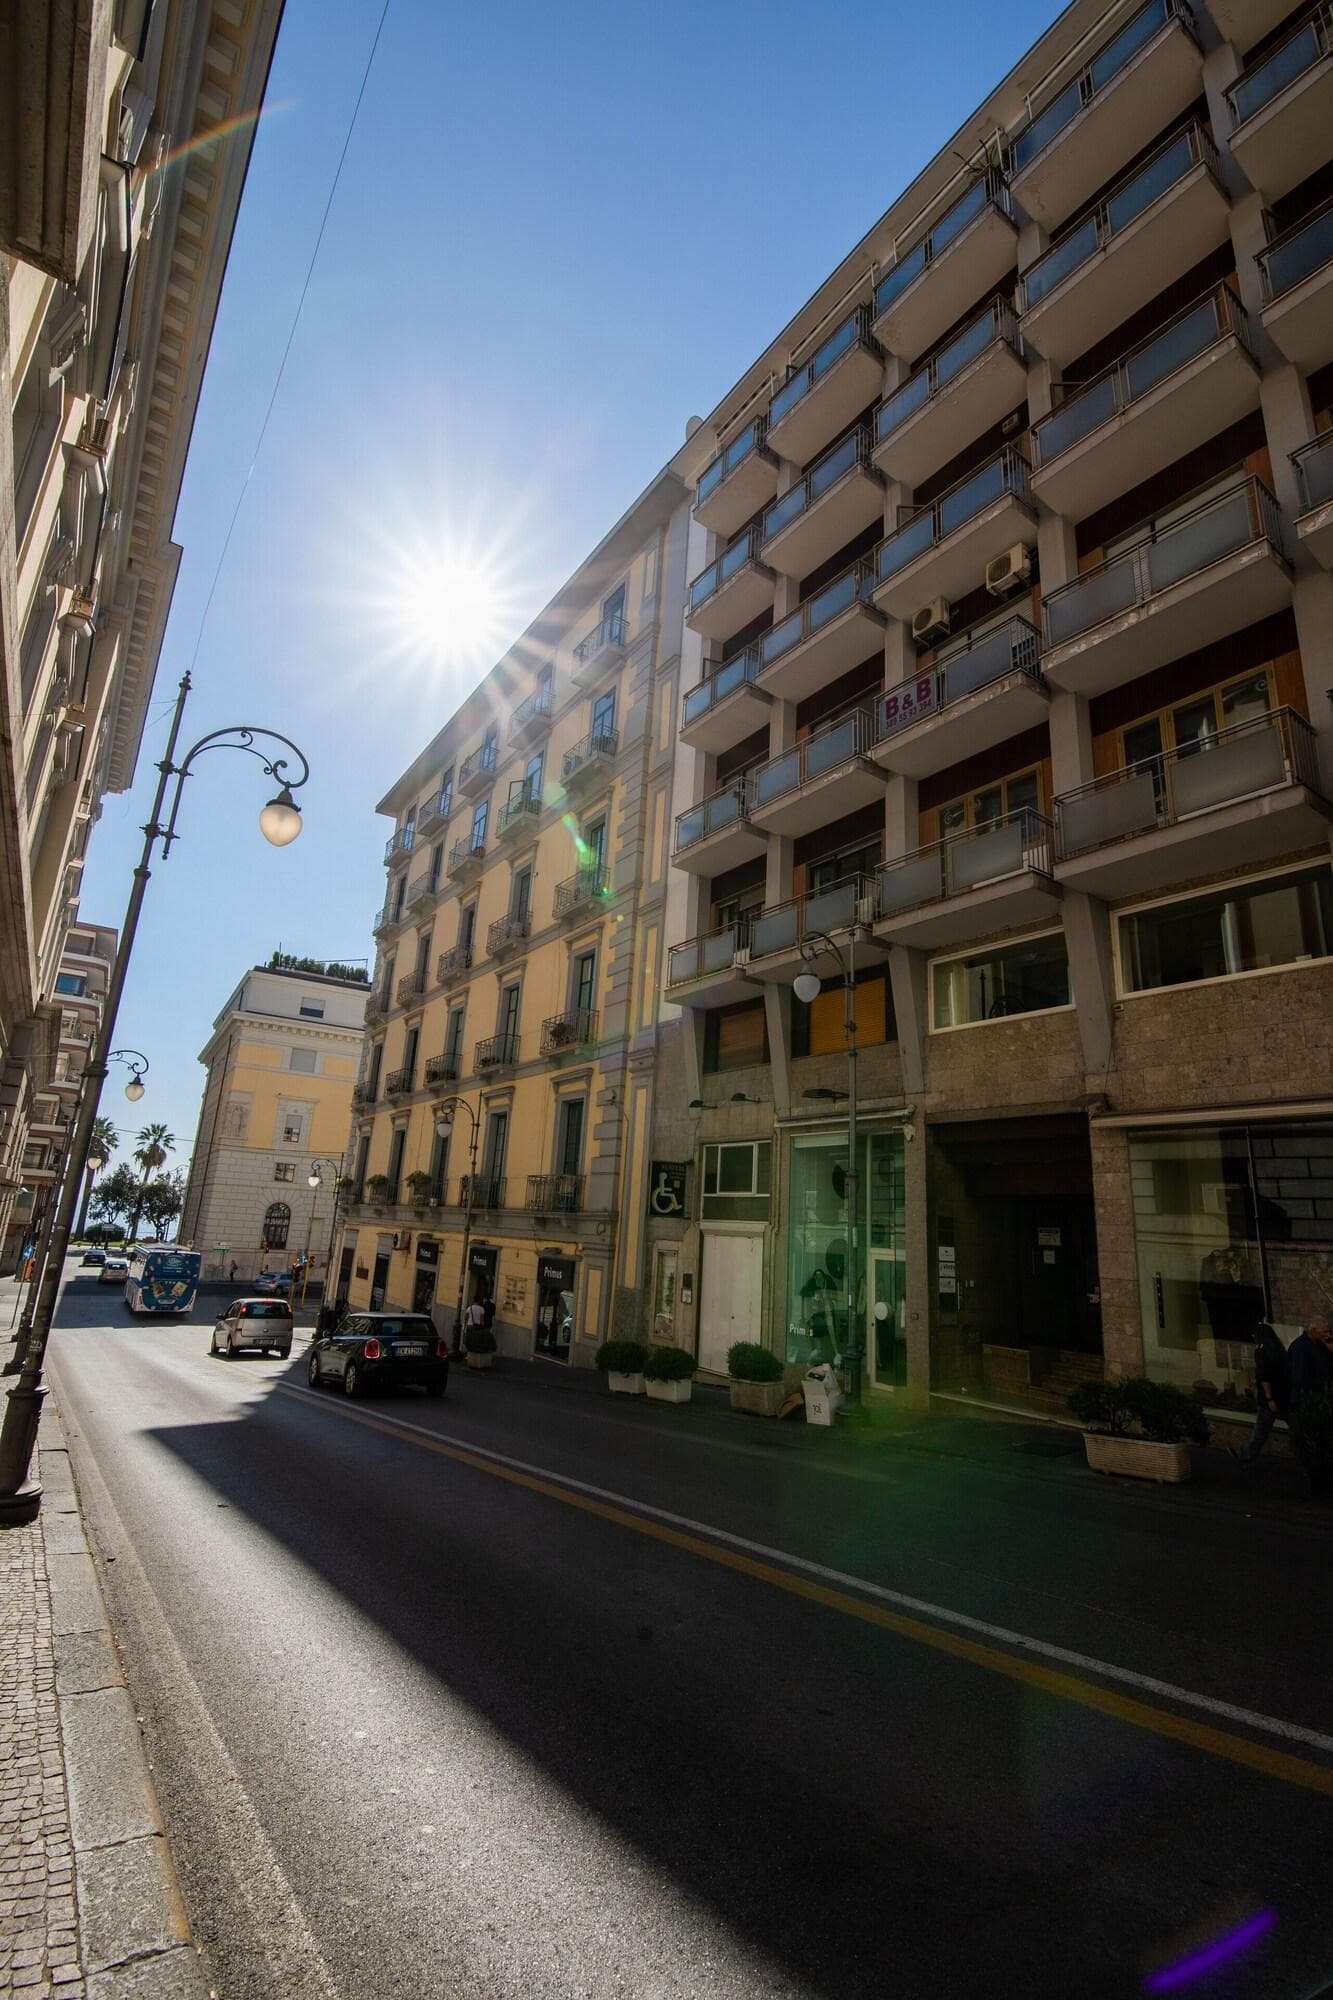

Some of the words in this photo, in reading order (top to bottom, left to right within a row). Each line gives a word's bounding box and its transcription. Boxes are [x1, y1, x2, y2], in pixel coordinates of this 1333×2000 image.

[886, 697, 899, 720] B
[902, 693, 913, 710] &
[916, 678, 931, 703] B
[473, 1255, 487, 1266] Primus
[544, 1266, 562, 1280] Primus
[789, 1323, 813, 1337] Prims
